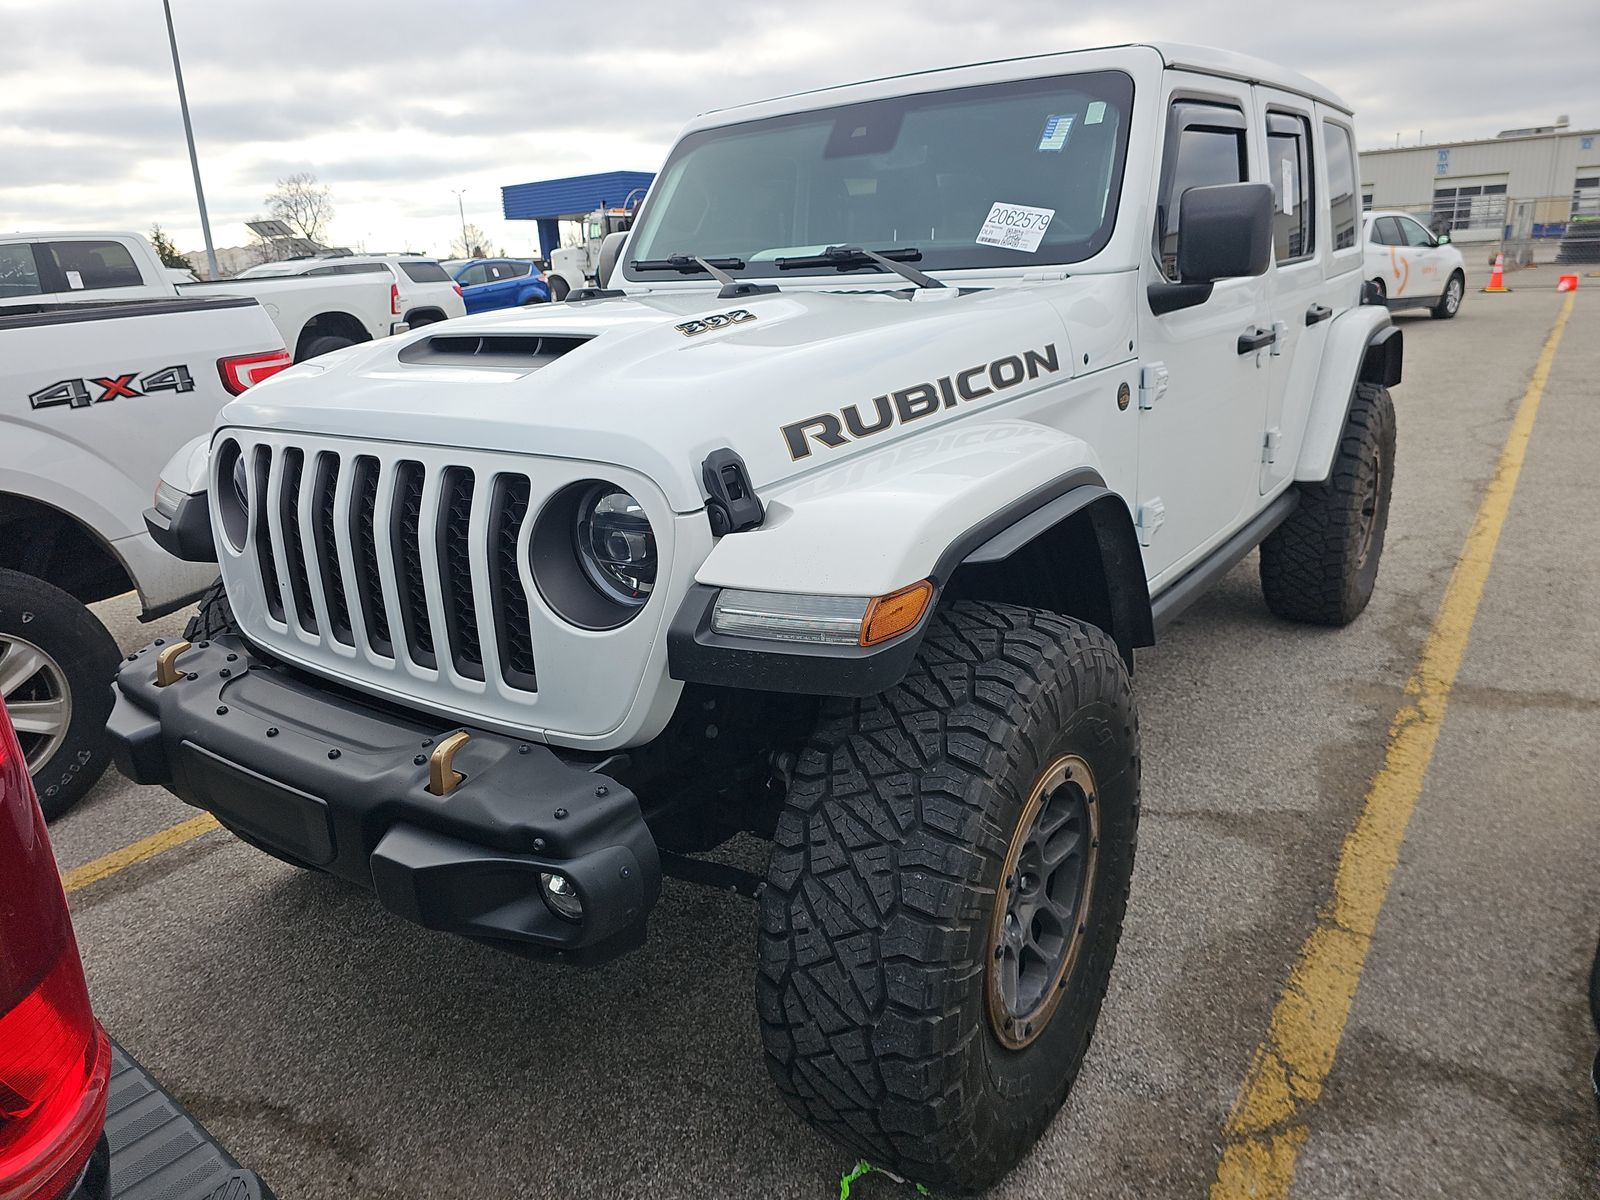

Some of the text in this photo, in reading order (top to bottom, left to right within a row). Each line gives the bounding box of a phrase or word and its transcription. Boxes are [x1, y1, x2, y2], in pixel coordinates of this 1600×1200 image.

[988, 208, 1051, 231] 2062579
[674, 309, 757, 337] 392
[780, 343, 1060, 462] RUBICON
